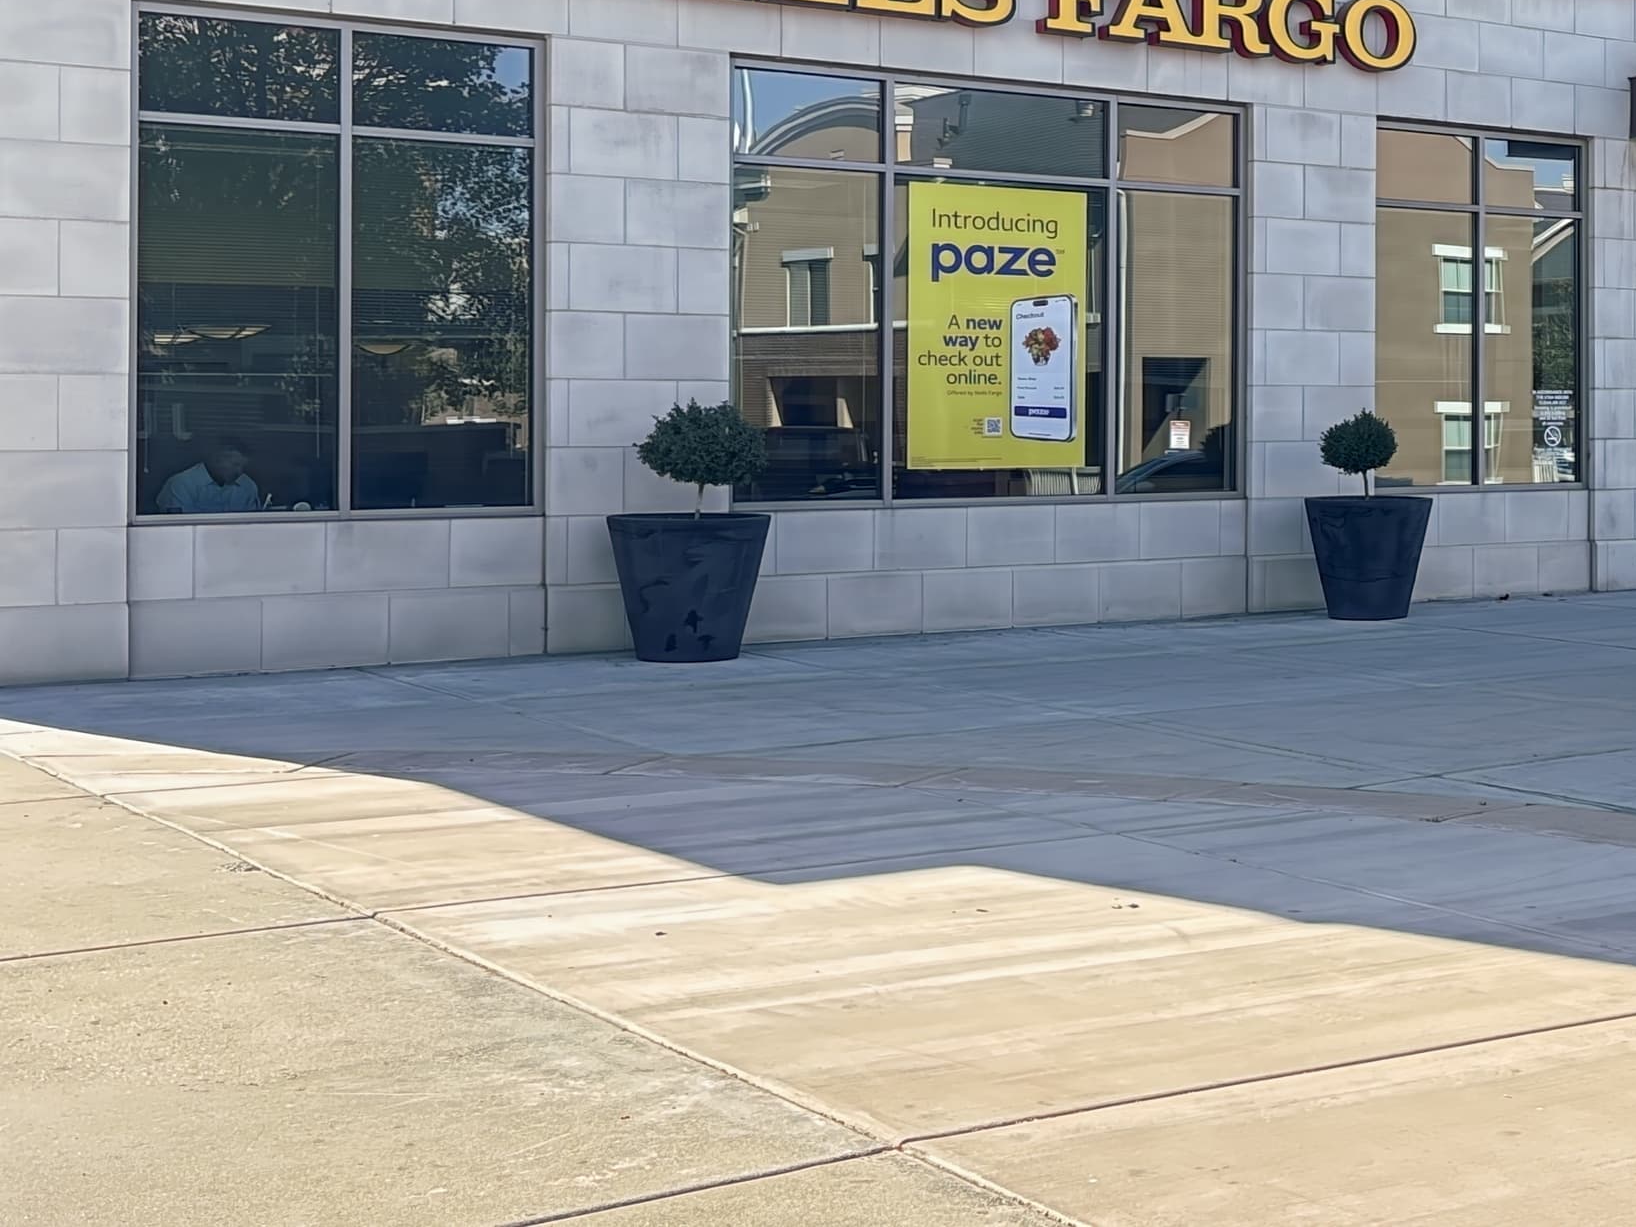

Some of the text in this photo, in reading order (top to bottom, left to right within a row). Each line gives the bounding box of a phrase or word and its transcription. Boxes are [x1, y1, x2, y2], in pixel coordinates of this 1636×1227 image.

[932, 208, 1058, 239] Introducing
[931, 243, 1057, 282] paze
[947, 314, 1003, 330] A new
[943, 334, 1002, 351] way to
[918, 350, 1003, 367] check out
[946, 369, 1002, 385] online.
